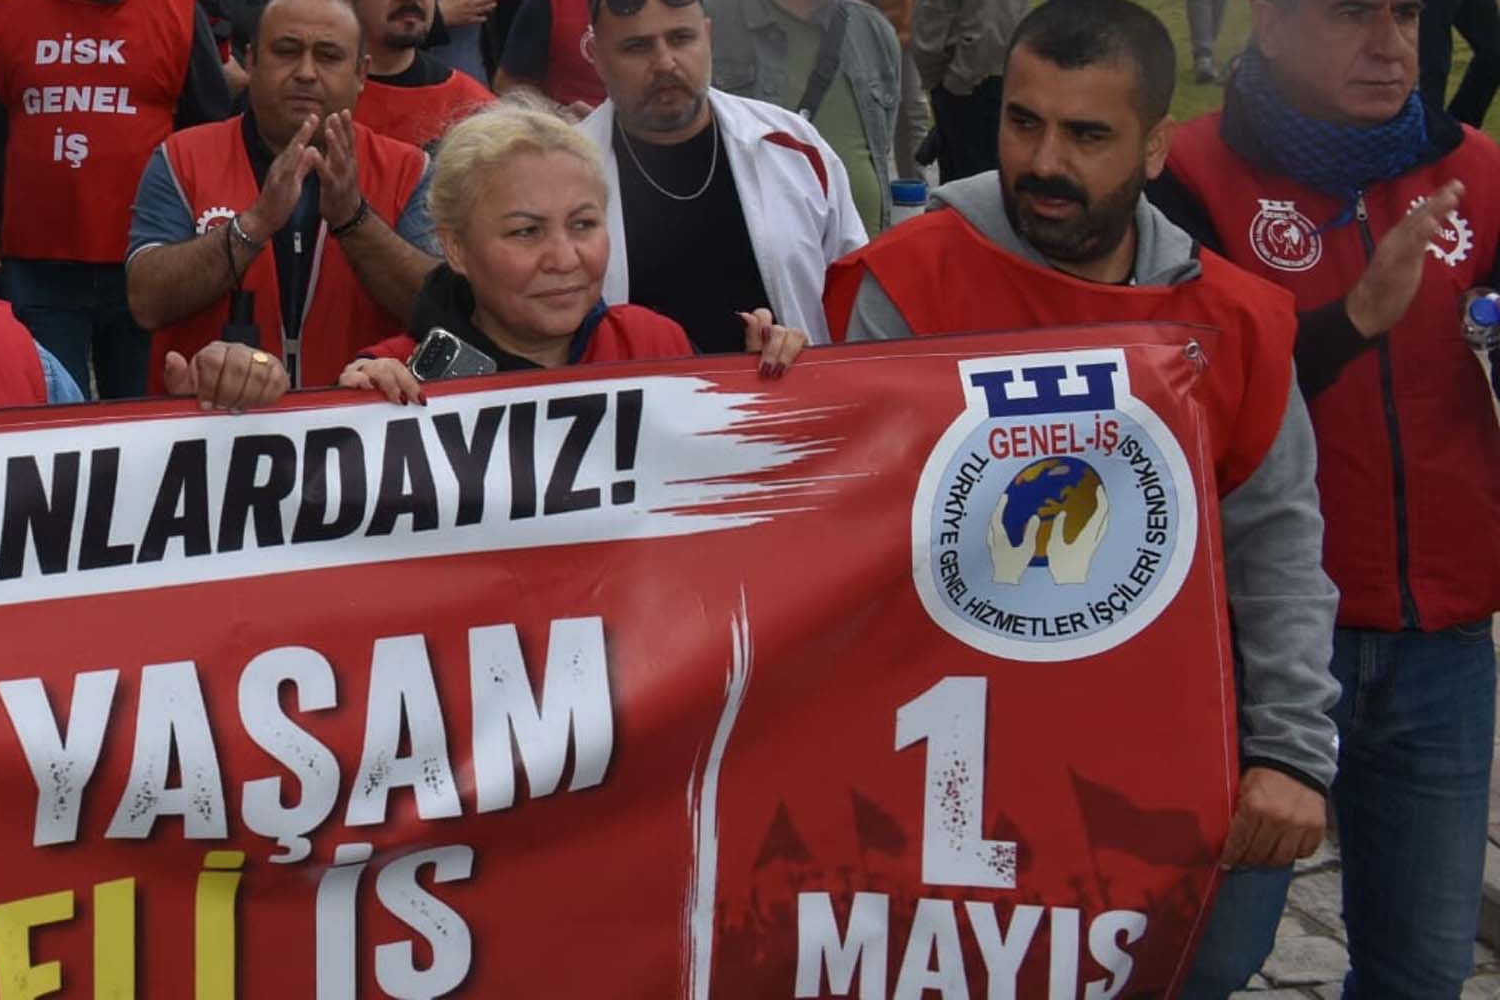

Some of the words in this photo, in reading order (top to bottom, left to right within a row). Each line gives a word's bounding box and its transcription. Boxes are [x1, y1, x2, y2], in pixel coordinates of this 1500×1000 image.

[34, 33, 126, 65] DİSK
[22, 86, 137, 115] GENEL
[53, 127, 89, 168] İŞ
[988, 413, 1120, 460] GENEL-İŞ
[940, 452, 990, 545] TÜRKİYE
[1118, 434, 1168, 546] SENDİKASI
[939, 550, 964, 606] GENEL
[1090, 546, 1162, 626] İŞÇİLERİ
[963, 598, 1089, 637] HİZMETLER
[894, 676, 1017, 889] 1
[795, 892, 1147, 1000] MAYIS
